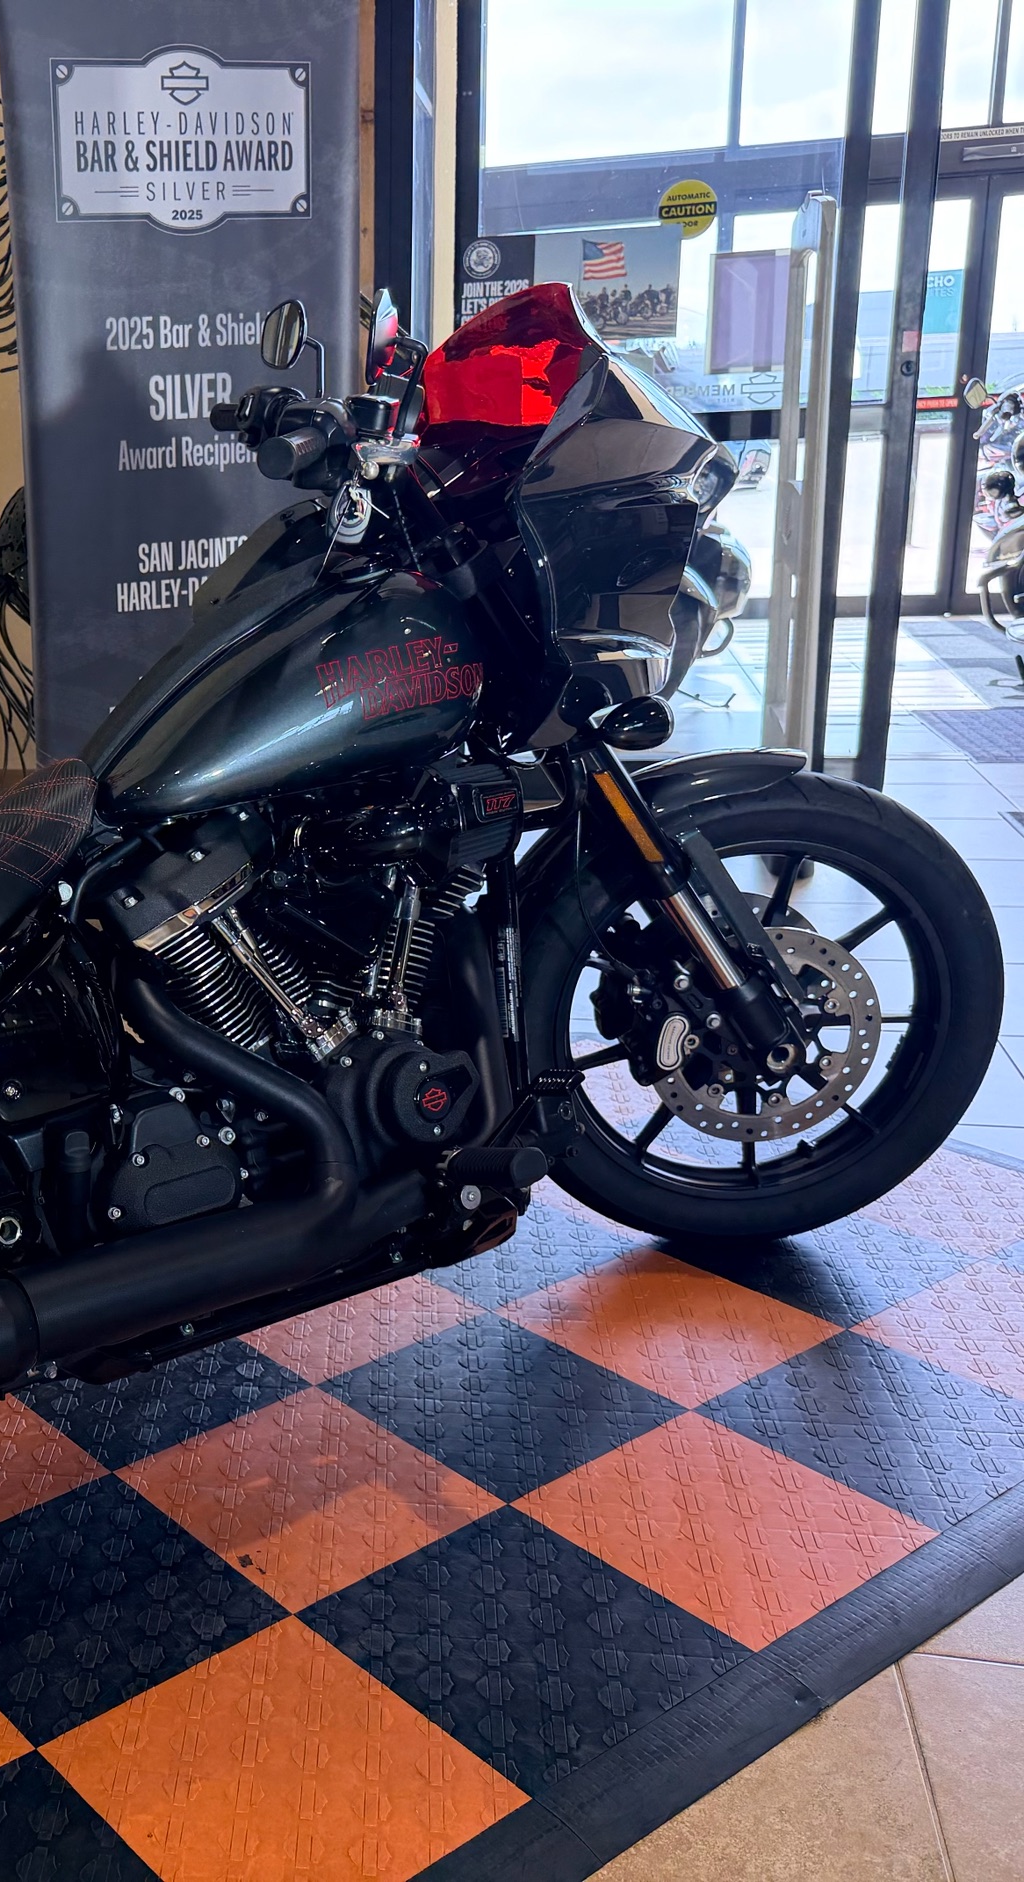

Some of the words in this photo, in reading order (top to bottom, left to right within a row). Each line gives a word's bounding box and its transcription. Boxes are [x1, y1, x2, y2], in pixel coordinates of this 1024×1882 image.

[74, 111, 292, 136] HARLEY-DAVIDSON
[961, 131, 978, 139] REMAIN
[979, 129, 1004, 137] UNLOCKED
[1005, 127, 1019, 135] WHEN
[75, 140, 118, 172] BAR
[124, 140, 139, 172] &
[145, 140, 218, 172] SHIELD
[223, 140, 294, 172] AWARD
[145, 181, 226, 202] SILVER
[666, 192, 711, 202] AUTOMATIC
[171, 209, 203, 221] 2025
[661, 203, 715, 218] CAUTION
[461, 281, 483, 299] JOIN
[484, 280, 503, 297] THE
[504, 279, 529, 296] 2026
[105, 316, 155, 351] 2025
[159, 315, 193, 349] Bar
[197, 313, 212, 347] &
[148, 372, 233, 422] SILVER
[118, 436, 176, 472] Award
[181, 434, 258, 473] Recipien
[138, 541, 173, 574] SAN
[116, 575, 209, 613] HARLEY-D
[315, 636, 459, 710] HARLEY-
[359, 662, 484, 721] DAVIDSON
